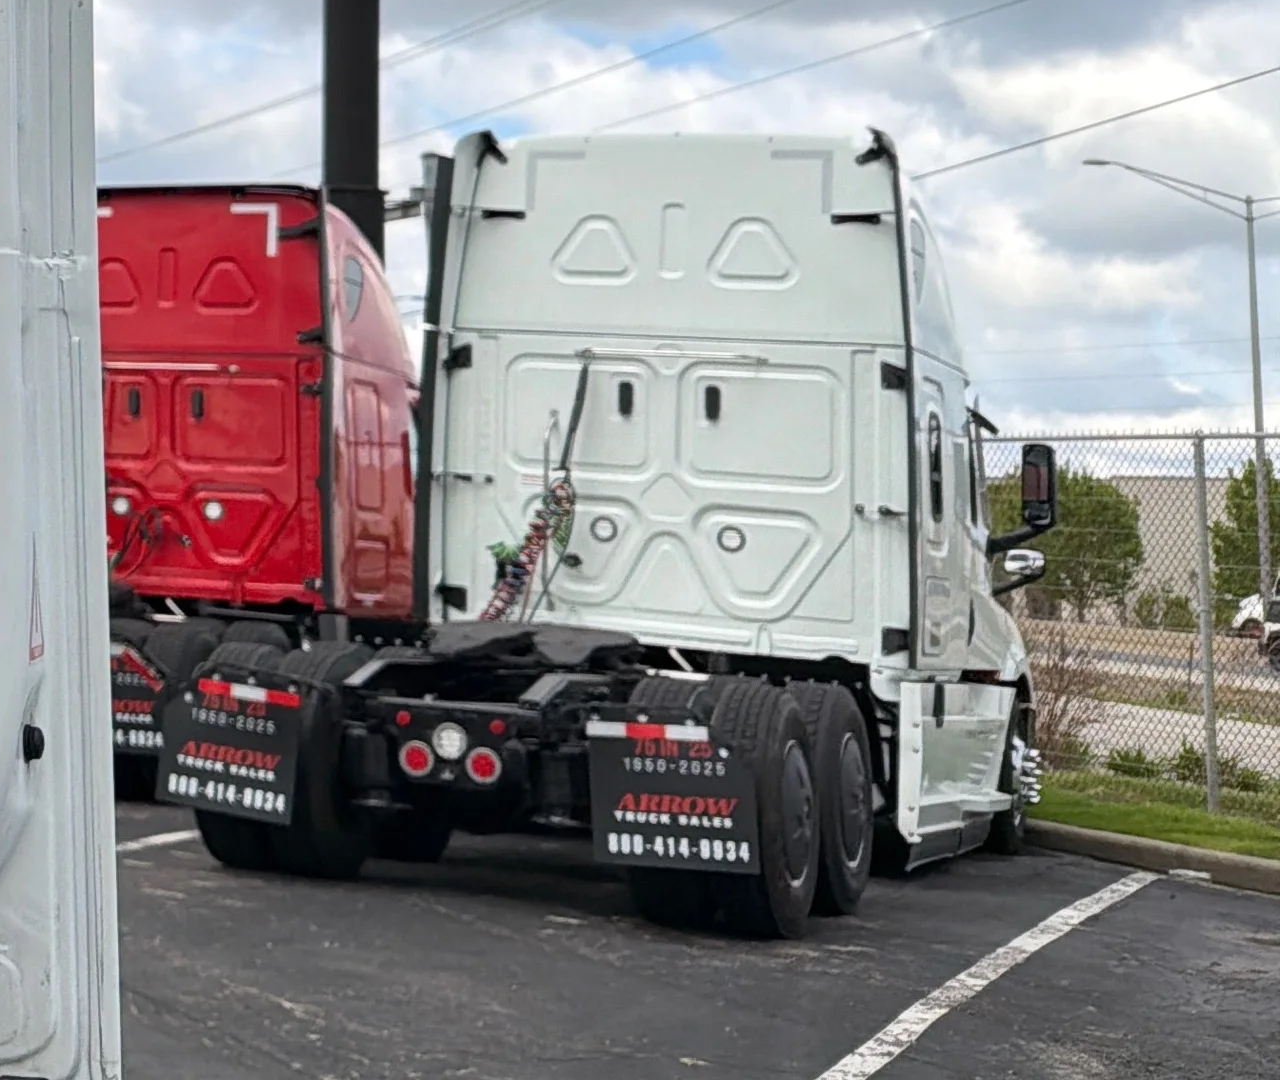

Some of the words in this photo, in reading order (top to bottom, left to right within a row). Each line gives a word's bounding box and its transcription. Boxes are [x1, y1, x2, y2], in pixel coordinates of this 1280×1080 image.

[180, 740, 282, 771] ARROW
[229, 764, 276, 781] SALES
[617, 792, 739, 817] ARROW
[612, 809, 671, 826] TRUCK
[677, 814, 733, 829] SALES
